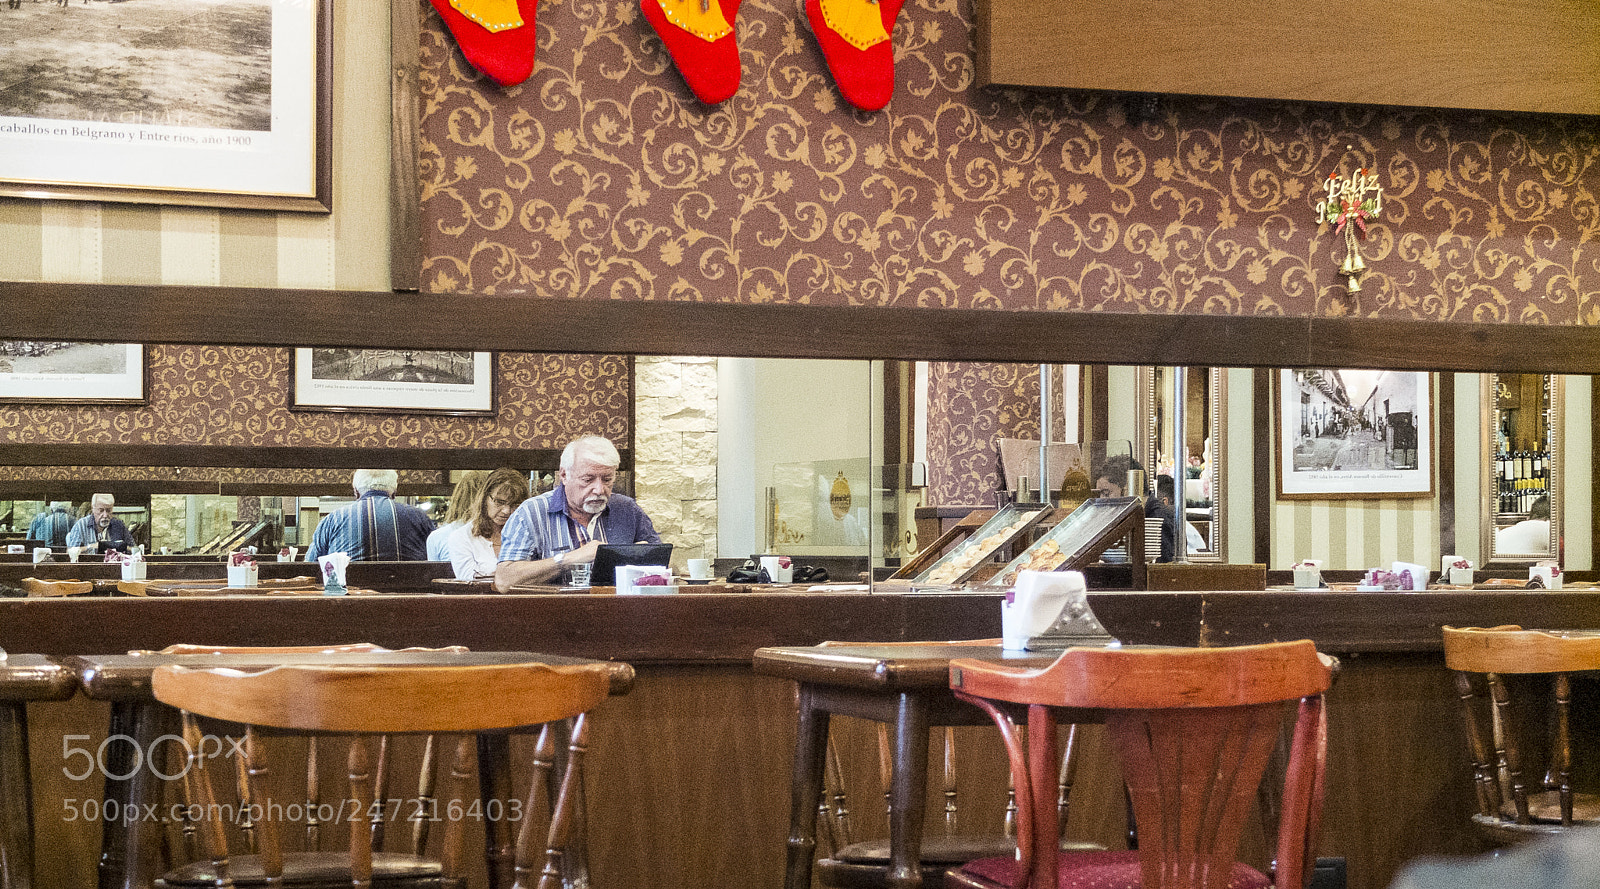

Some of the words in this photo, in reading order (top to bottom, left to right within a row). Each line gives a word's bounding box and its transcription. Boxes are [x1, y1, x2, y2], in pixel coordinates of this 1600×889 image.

[0, 123, 50, 135] caballos
[53, 128, 68, 136] en
[72, 126, 125, 140] Belgrano
[128, 131, 135, 142] y
[139, 130, 170, 141] Entre
[201, 134, 223, 145] año
[226, 135, 252, 145] 1900
[1323, 168, 1380, 199] Feliz
